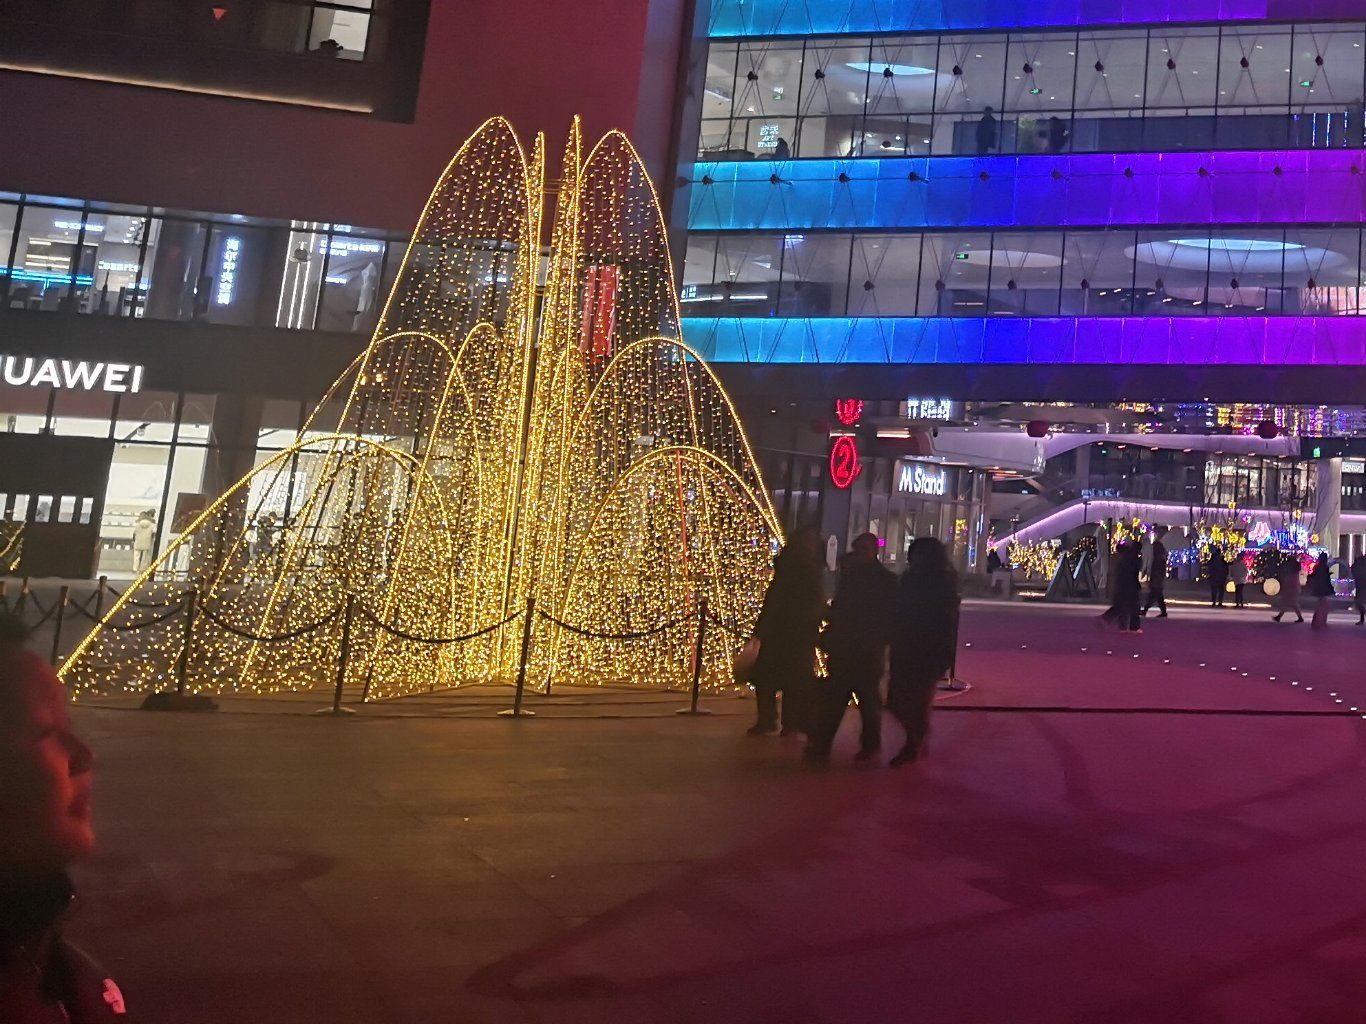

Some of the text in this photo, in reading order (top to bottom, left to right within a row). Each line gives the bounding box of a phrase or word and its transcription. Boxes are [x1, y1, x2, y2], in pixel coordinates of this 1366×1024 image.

[0, 355, 144, 393] UAWEI
[898, 465, 945, 495] M Stand
